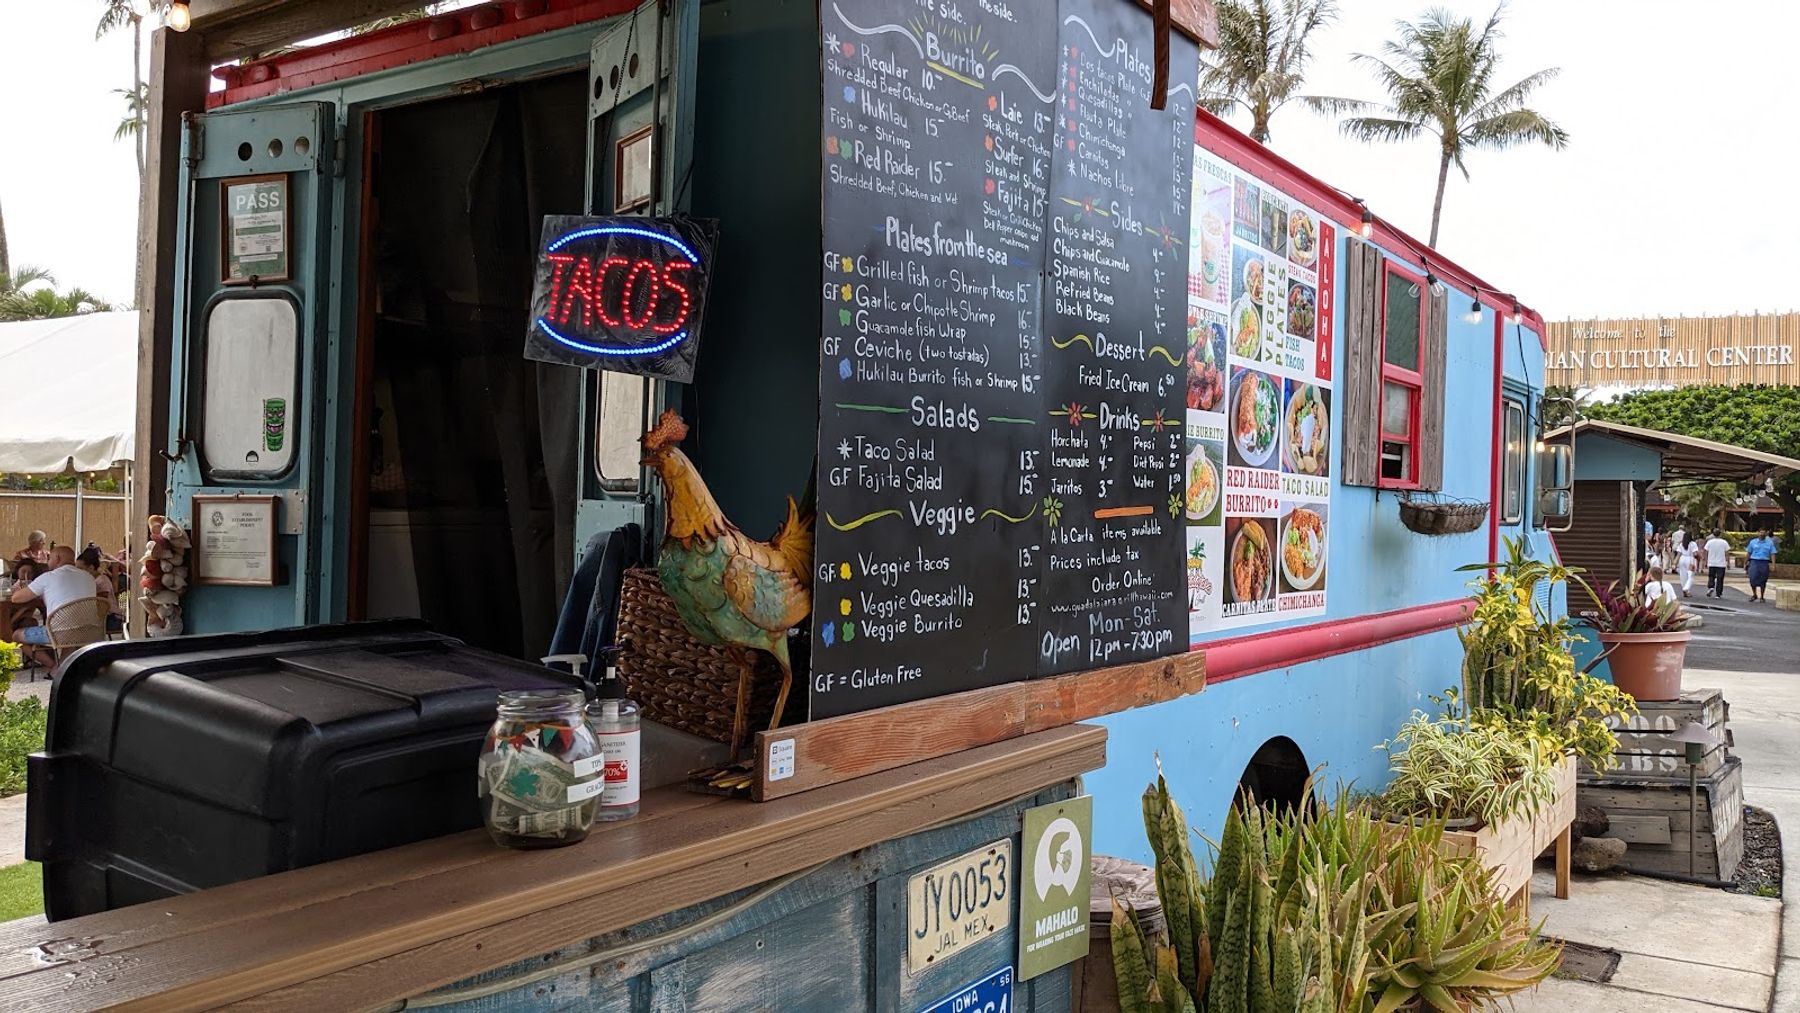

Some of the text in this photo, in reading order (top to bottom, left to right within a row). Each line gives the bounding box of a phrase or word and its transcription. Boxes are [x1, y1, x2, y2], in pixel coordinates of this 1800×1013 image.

[861, 43, 908, 80] Regular
[926, 31, 985, 80] Burrito
[1116, 38, 1152, 84] Plates
[827, 59, 877, 88] Shredded
[880, 77, 902, 100] Beef
[1000, 90, 1024, 124] Laie
[830, 107, 911, 152] Fish or Shrimp
[1079, 122, 1126, 160] Chimichanga
[854, 140, 921, 180] Red Raider
[994, 136, 1024, 168] Surfer
[1054, 133, 1109, 169] GF Carnitas
[830, 164, 873, 191] Shredded
[898, 182, 928, 201] Chicken
[930, 192, 942, 204] and
[985, 160, 1046, 200] Steak and Shrimp
[1080, 162, 1112, 188] Nachos
[236, 191, 280, 210] PASS
[998, 180, 1030, 213] Fajita
[1054, 216, 1115, 249] Chips and Salsa
[1110, 201, 1143, 236] Sides
[885, 216, 1008, 266] Plates from the sea
[1054, 238, 1130, 272] Chips and Guacamole
[824, 251, 1014, 301] GF Grilled fish or Shrimp tacos
[1054, 259, 1110, 284] Spanish Rice
[546, 253, 692, 334] TACOS
[823, 283, 996, 328] GF Garlic or Chipotle Shrimp
[1056, 280, 1114, 306] Refried Beans
[1319, 238, 1332, 363] ALOHA
[1056, 298, 1110, 324] Black Beans
[1266, 260, 1276, 362] VEGGIE
[1276, 267, 1286, 366] PLATES
[856, 310, 967, 344] Guacamole fish Wrap
[1572, 326, 1676, 340] Welcome to the
[824, 336, 990, 368] GF Ceviche (two tostadas)
[1096, 330, 1145, 361] Dessert
[1286, 335, 1300, 353] FISH
[1590, 345, 1794, 369] CULTURAL CENTER
[856, 360, 1018, 392] Hukilau Burrito fish or Shrimp
[1285, 353, 1305, 372] TACOS
[1079, 364, 1150, 394] Fried Ice Cream
[911, 395, 980, 432] Salads
[1100, 402, 1141, 431] Drinks
[854, 435, 936, 462] Taco Salad
[1051, 428, 1089, 449] Horchata
[1134, 436, 1156, 450] Pepsi
[1195, 426, 1224, 440] BURRITO
[1052, 451, 1090, 468] Lemonade
[1134, 455, 1164, 470] Diet Pepsi
[858, 464, 944, 492] Fajita Salad
[1051, 478, 1082, 496] Jarritos
[1133, 474, 1156, 488] Water
[1226, 468, 1280, 490] RED RAIDER
[1282, 478, 1328, 498] TACO SALAD
[909, 498, 976, 536] Veggie
[1226, 494, 1266, 512] BURRITO
[1050, 518, 1163, 545] A la items available
[858, 546, 950, 588] Veggie tacos
[1050, 545, 1140, 572] Prices include tax
[1092, 569, 1152, 594] Order Online
[860, 584, 974, 620] Veggie Quesadilla
[1222, 602, 1256, 618] CARNITAS
[1278, 593, 1325, 610] CHIMICHANGA
[861, 614, 964, 643] Veggie Burrito
[1041, 630, 1080, 664] Open
[815, 673, 835, 693] GF
[851, 669, 893, 689] Gluten
[897, 664, 923, 683] Free
[1608, 748, 1678, 772] LBS
[915, 854, 1007, 940] JY0053
[934, 914, 988, 954] JAL MEX
[1035, 906, 1079, 938] MAHALO
[1054, 932, 1064, 942] YOUR
[952, 990, 979, 1013] IOWA
